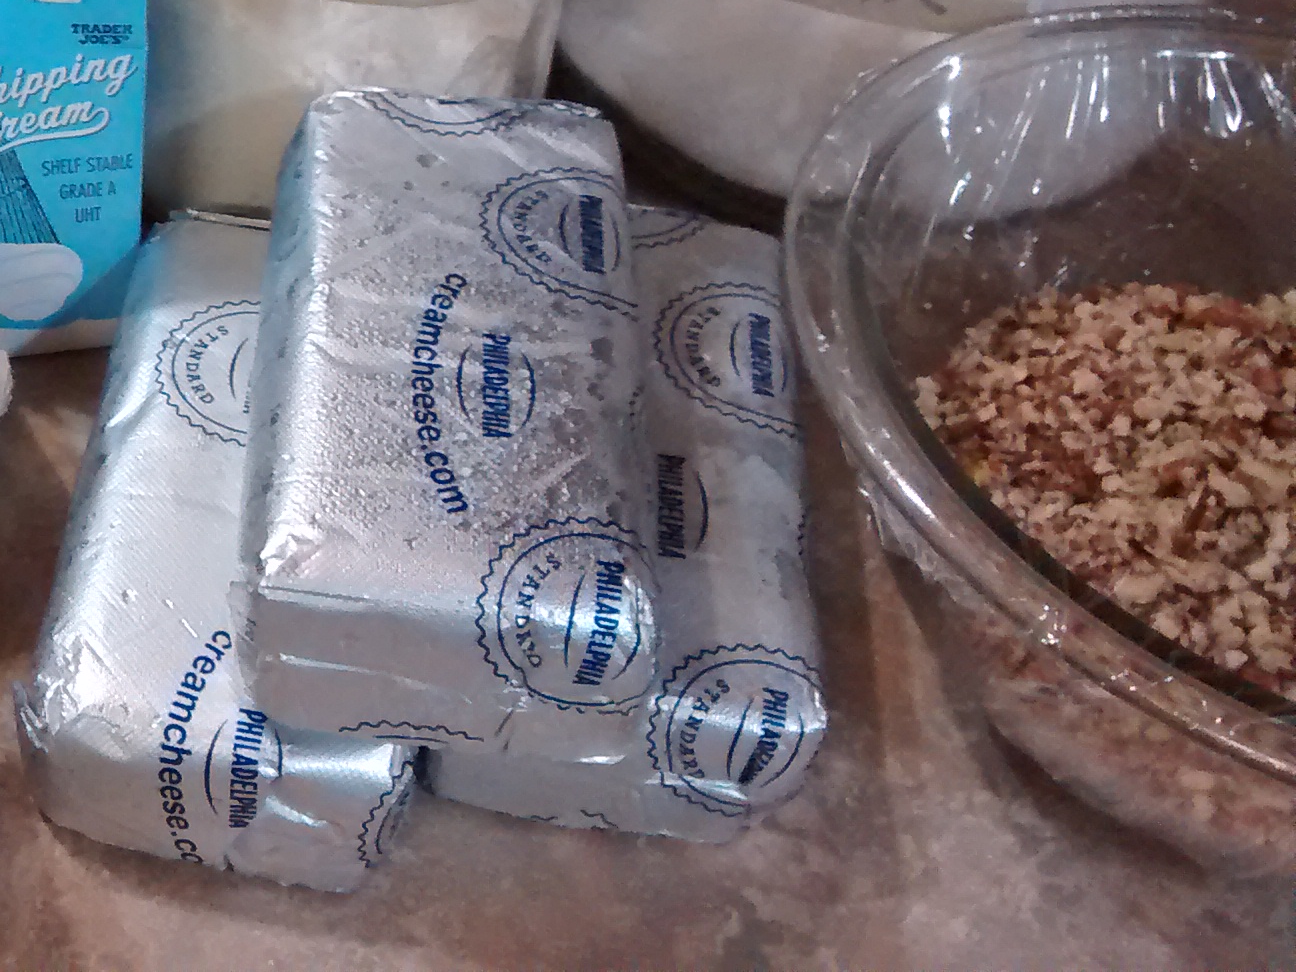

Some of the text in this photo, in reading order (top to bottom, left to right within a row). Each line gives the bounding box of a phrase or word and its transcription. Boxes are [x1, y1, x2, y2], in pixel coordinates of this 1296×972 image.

[70, 23, 133, 34] TRADER
[41, 153, 133, 177] SHELF STABLE
[59, 181, 117, 200] GRADE A
[74, 206, 102, 224] UHT
[185, 325, 230, 405] STANDARD
[410, 272, 470, 516] creamcheese.com
[572, 559, 626, 687] PHILADELPHIA
[228, 708, 269, 829] PHILADELPHIA
